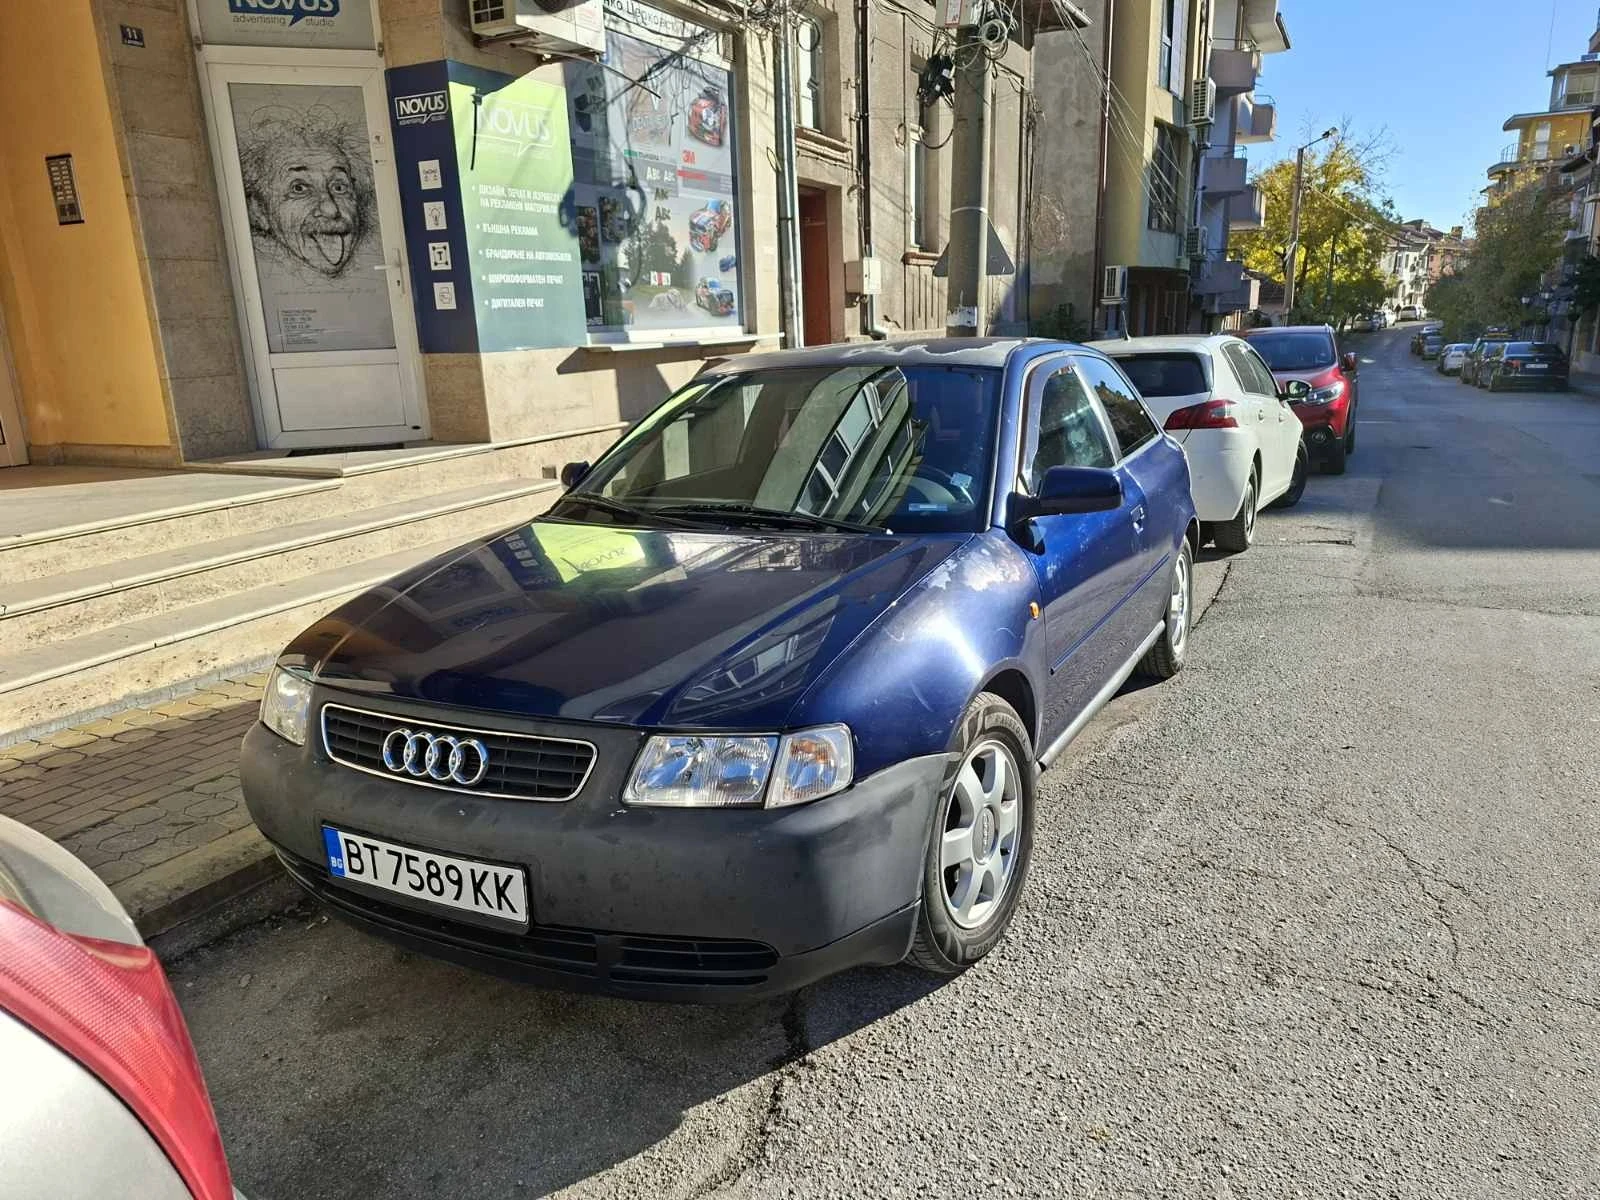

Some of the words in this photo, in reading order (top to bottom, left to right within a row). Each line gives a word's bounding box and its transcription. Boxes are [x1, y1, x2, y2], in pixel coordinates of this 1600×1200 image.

[400, 95, 445, 115] NOVUS
[477, 107, 550, 141] NOVUS
[331, 856, 343, 869] BG
[344, 838, 380, 880] BT
[386, 849, 463, 901] 7589
[470, 868, 518, 914] KK
